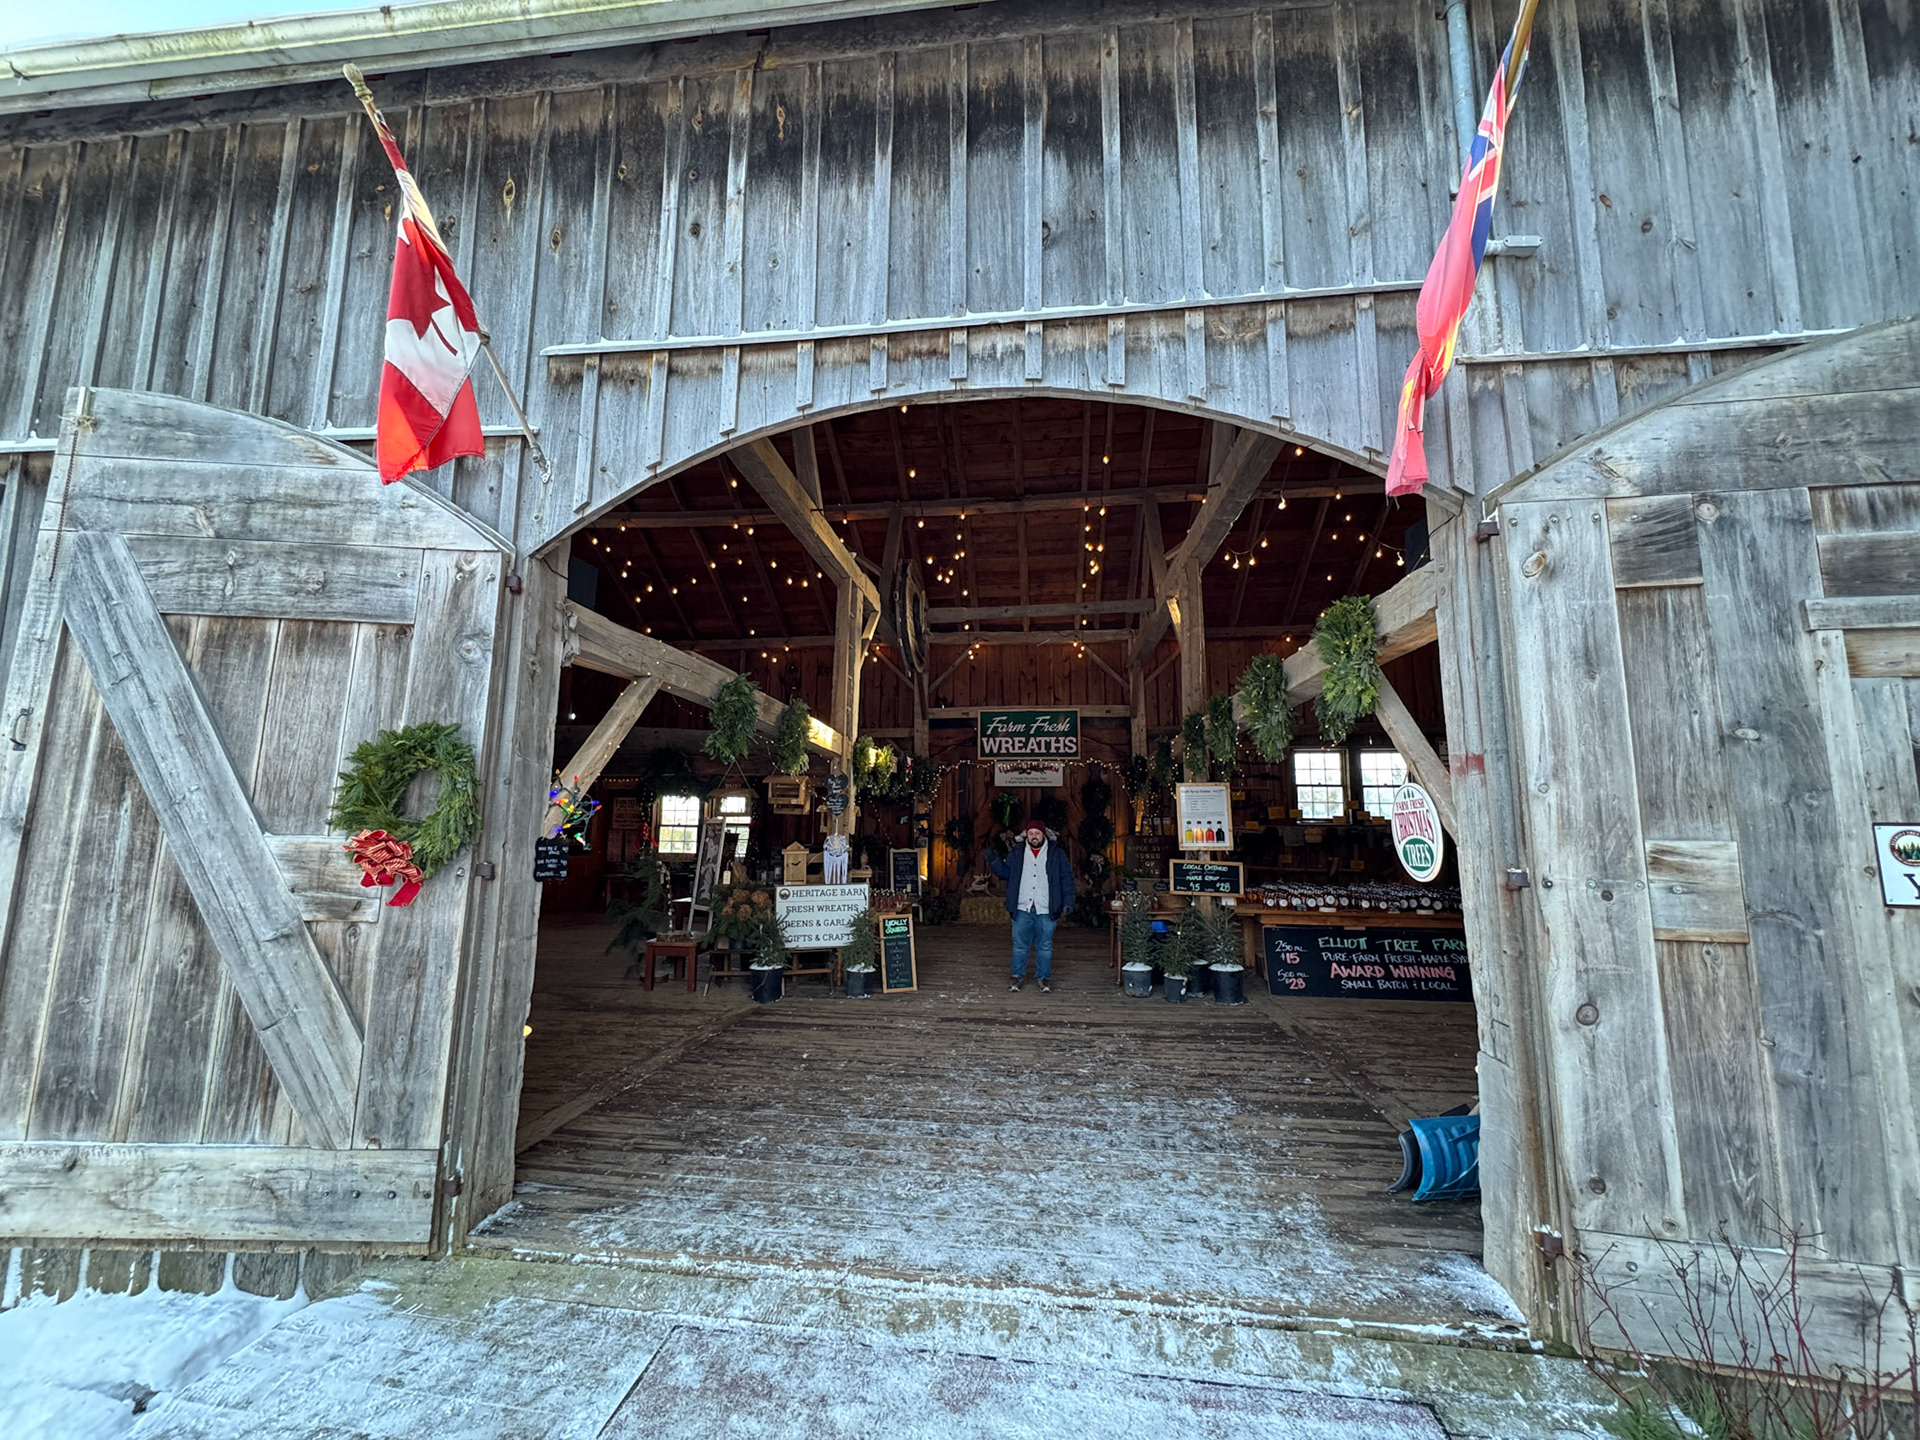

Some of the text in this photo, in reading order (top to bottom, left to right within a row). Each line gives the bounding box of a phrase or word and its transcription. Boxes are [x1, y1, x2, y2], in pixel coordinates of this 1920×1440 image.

[986, 716, 1070, 734] Farm Fresh
[982, 736, 1077, 754] WREATHS
[1396, 798, 1425, 811] FARM FRESH
[1395, 809, 1434, 845] CHRISTMAS
[1405, 844, 1432, 867] TREES
[792, 888, 866, 897] HERITAGE BARN
[1190, 882, 1200, 891] $15
[1216, 882, 1231, 892] $28
[817, 904, 858, 912] WREATHS
[1275, 940, 1293, 952] 250
[1318, 936, 1367, 950] ELLIOTT
[1376, 939, 1422, 952] TREE
[1280, 952, 1300, 964] $15
[1384, 953, 1416, 963] FRESH
[1420, 954, 1450, 964] MAPLE
[1451, 954, 1469, 964] SYR
[1278, 968, 1295, 981] 500
[1330, 962, 1456, 981] AWARD WINNING
[1285, 978, 1306, 989] $28
[1341, 980, 1374, 989] SMALL
[1377, 979, 1409, 990] BATCH
[1421, 981, 1458, 990] LOCAL
